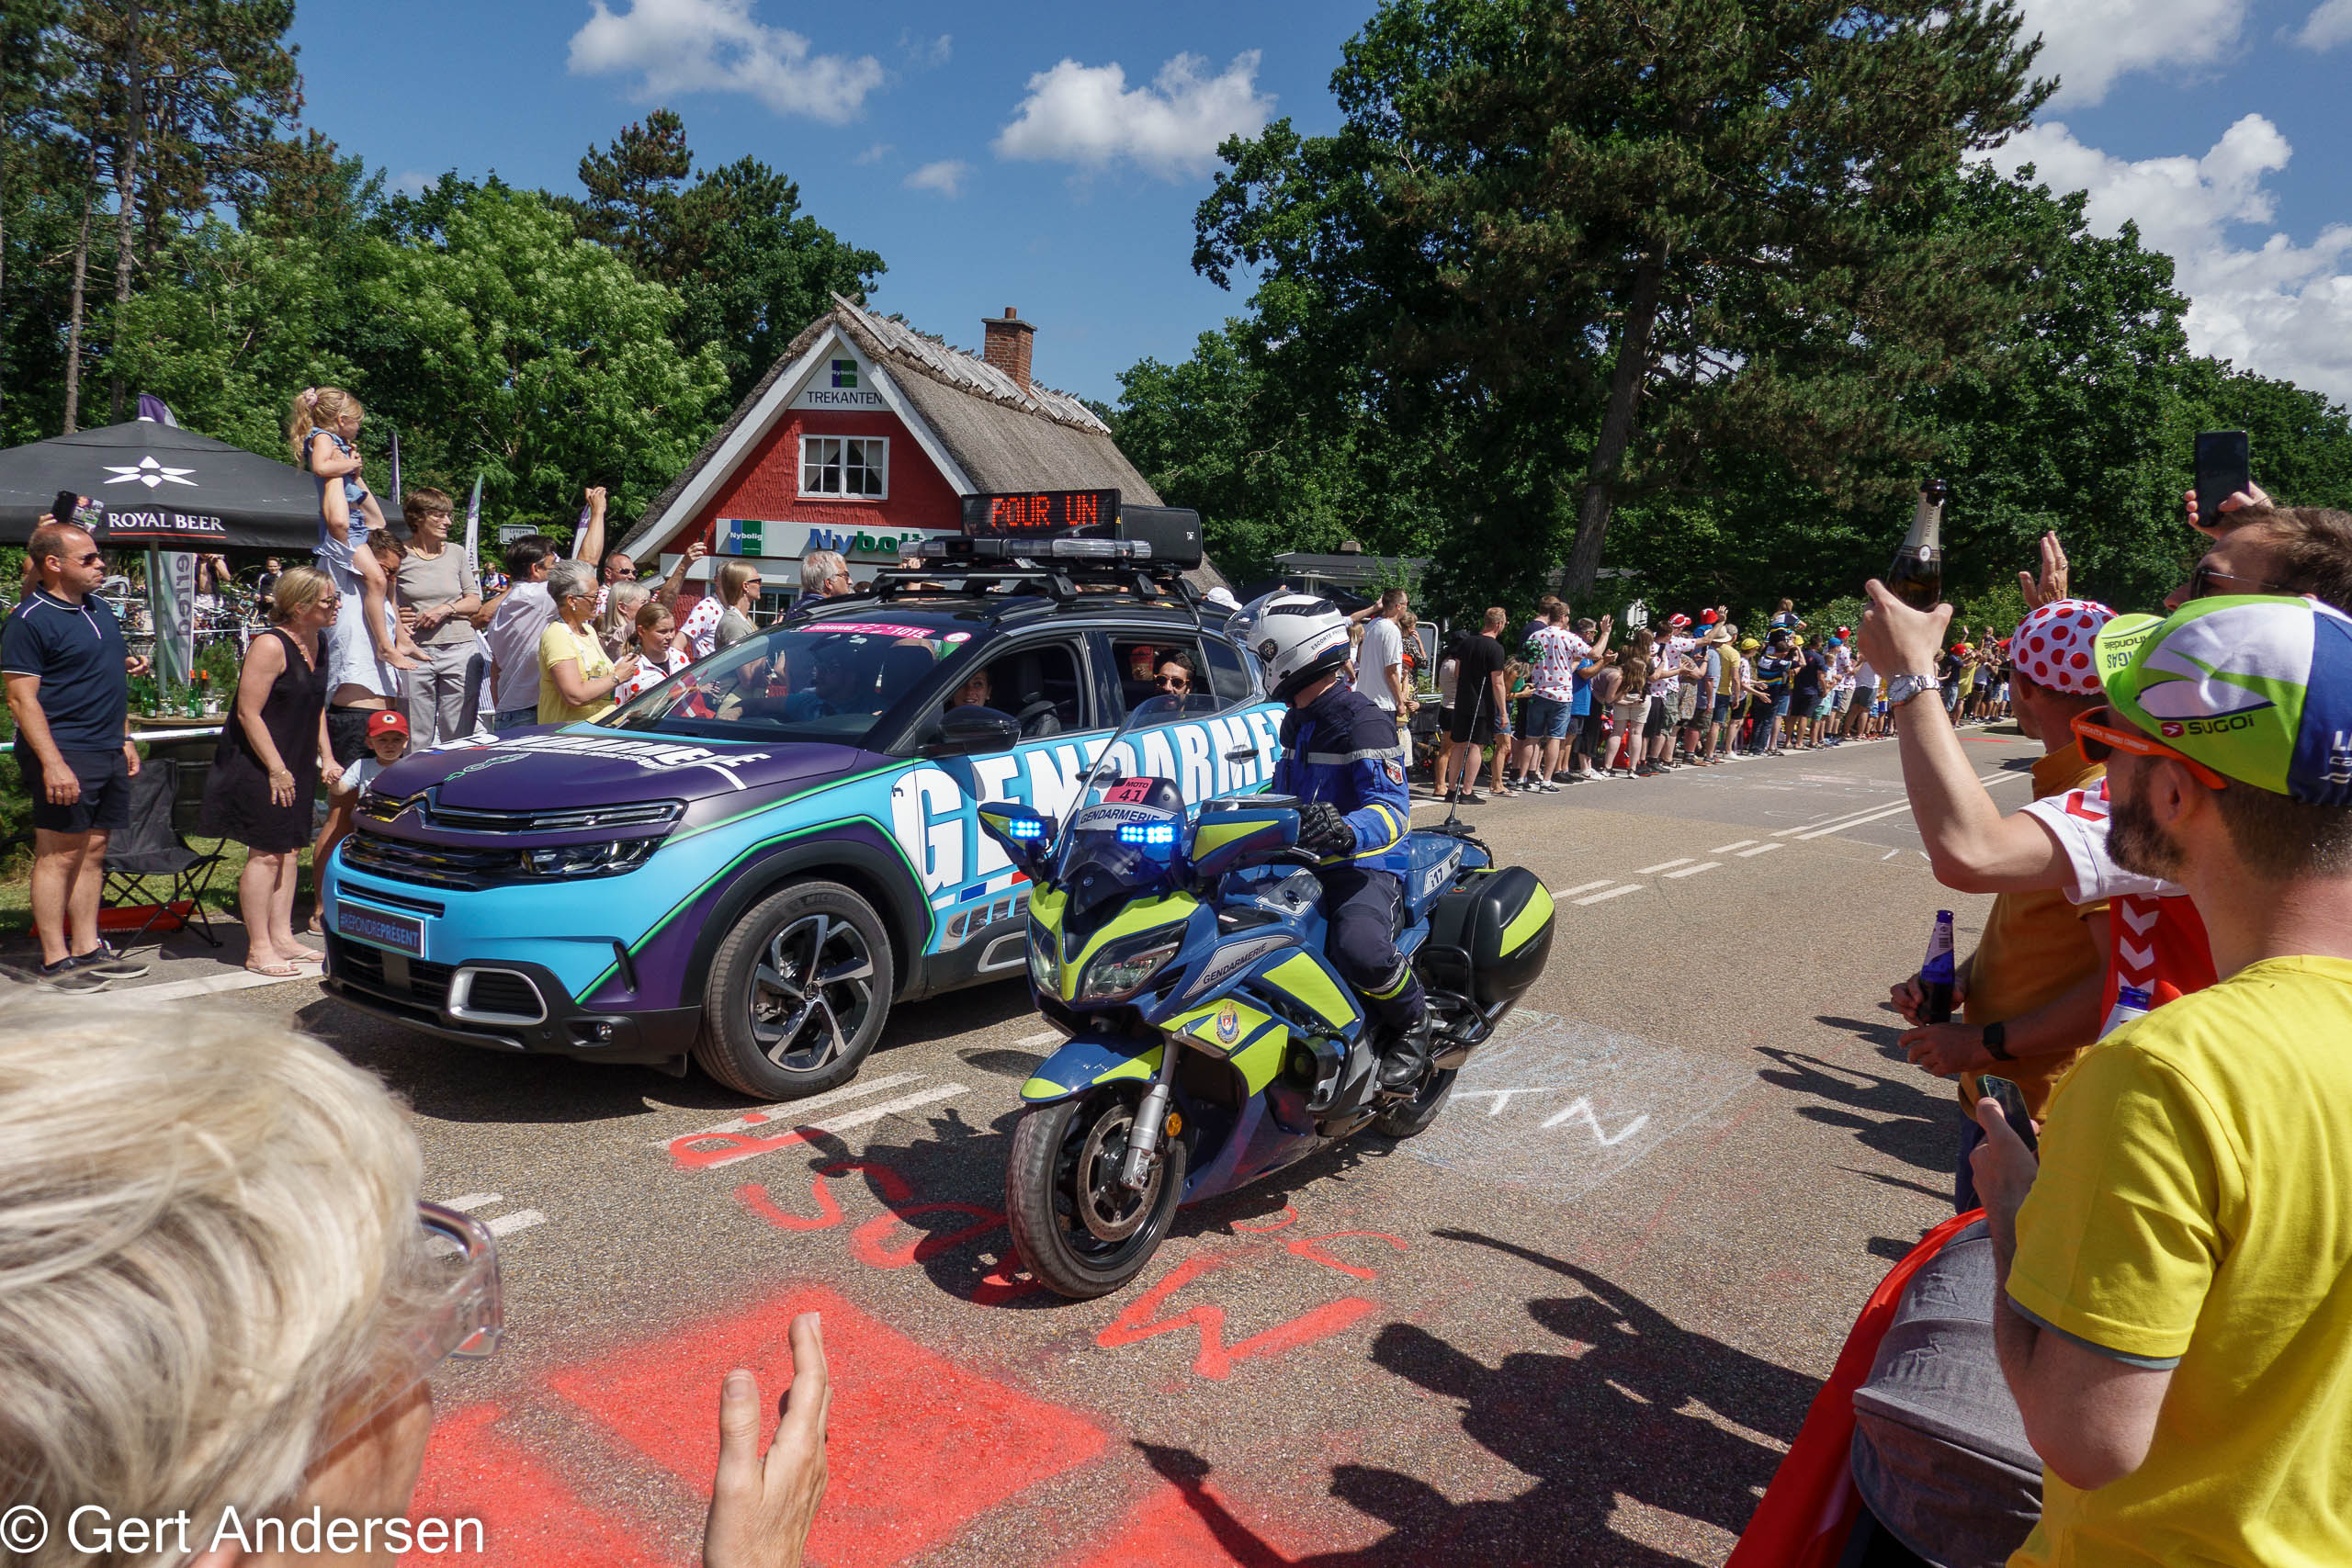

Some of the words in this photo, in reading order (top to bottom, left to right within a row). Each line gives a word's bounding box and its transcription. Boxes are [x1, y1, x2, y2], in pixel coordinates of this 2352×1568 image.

[807, 390, 883, 404] TREKANTEN
[991, 496, 1050, 527] POUR
[1066, 494, 1097, 525] UN
[107, 512, 172, 529] ROYAL
[175, 513, 226, 531] BEER
[729, 531, 763, 541] Nybolig
[890, 626, 929, 639] 1015
[1118, 788, 1143, 803] 41
[1203, 942, 1268, 985] GENDARMERIE
